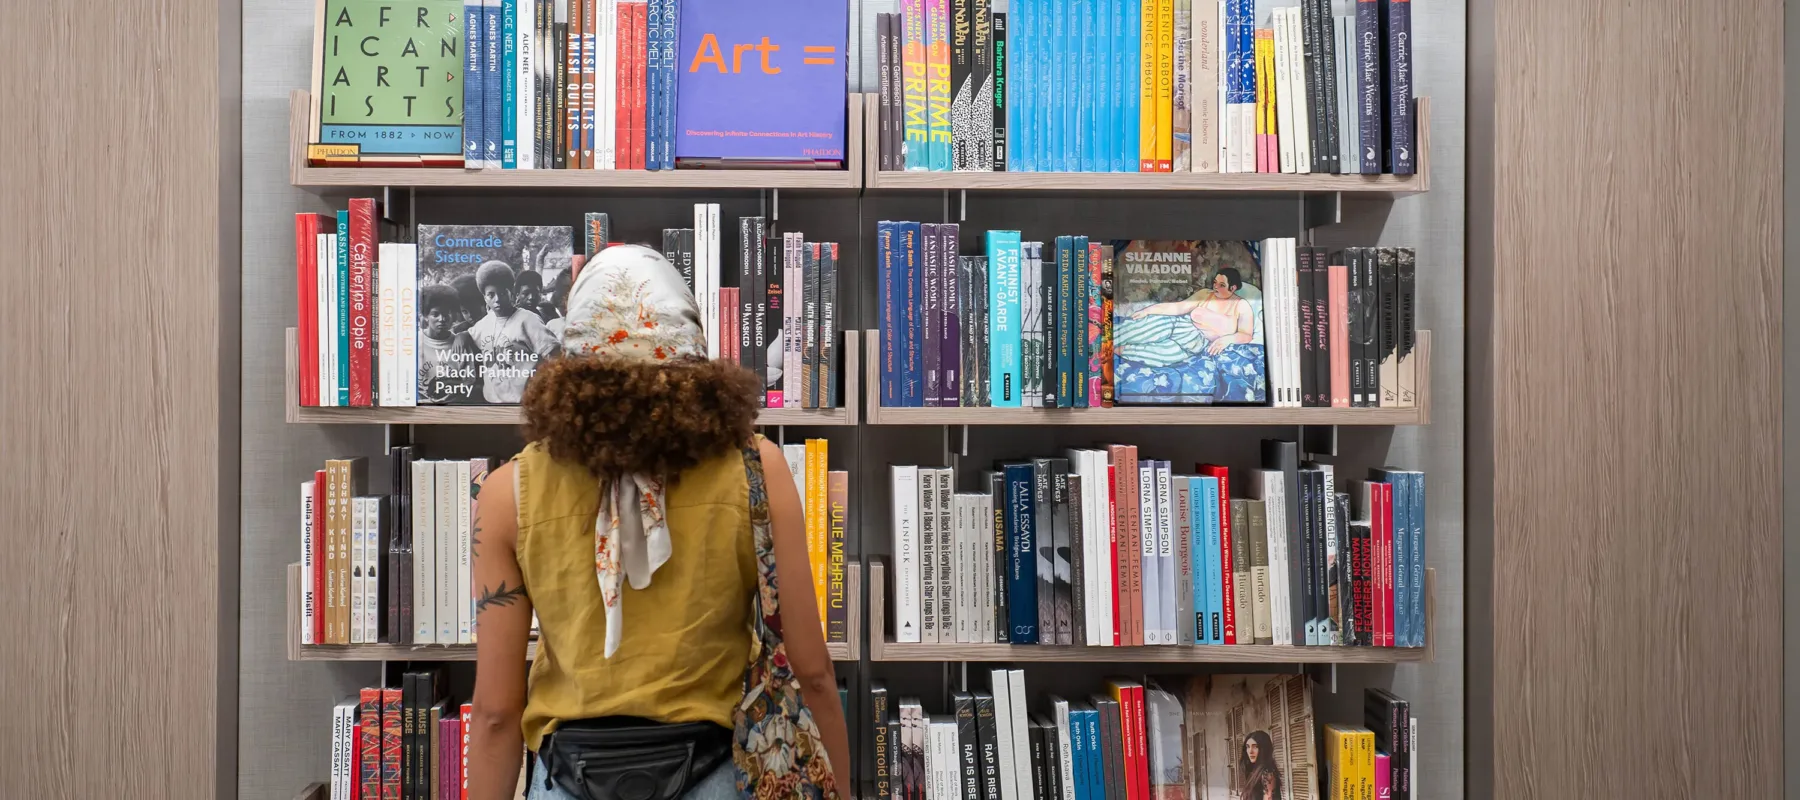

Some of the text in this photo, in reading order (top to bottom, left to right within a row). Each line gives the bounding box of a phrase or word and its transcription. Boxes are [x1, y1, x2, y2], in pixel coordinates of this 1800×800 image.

[906, 5, 914, 55] GENERATION
[1201, 20, 1209, 70] wonderland
[689, 33, 782, 75] Art
[567, 33, 579, 130] AMISH QUILTS
[582, 33, 594, 130] AMISH QUILTS
[995, 40, 1004, 108] Barbara Kruger
[1364, 32, 1374, 115] Carrie Mae Weems
[904, 61, 927, 142] PRIME
[929, 62, 951, 144] PRIME
[316, 148, 356, 156] PHAIDON
[331, 130, 455, 140] FROM 1882 NOW
[686, 130, 724, 138] Discovering
[809, 131, 833, 139] History
[338, 223, 346, 266] CASSATT
[435, 234, 502, 248] Comrade
[435, 251, 482, 264] Sisters
[1125, 252, 1192, 263] SUZANNE
[1007, 249, 1018, 304] FEMINIST
[1125, 264, 1192, 275] VALADON
[353, 243, 367, 349] Catherine Opie
[996, 248, 1007, 332] AVANT-GARDE
[435, 349, 538, 362] Women of the
[1060, 330, 1068, 357] Popular
[436, 365, 537, 378] Black Panther
[436, 381, 473, 398] Party
[924, 474, 933, 489] Kara
[1011, 481, 1019, 503] Crossing
[924, 489, 933, 510] Walker
[1019, 481, 1031, 552] LALLA ESSAYDI
[1142, 470, 1152, 554] LORNA SIMPSON
[1158, 471, 1169, 554] LORNA SIMPSON
[1325, 474, 1335, 547] LYNDA BENGLIS
[924, 516, 933, 531] Black
[924, 532, 934, 544] Hole
[995, 509, 1004, 552] KUSAMA
[1178, 488, 1190, 576] Louise Bourgeois
[304, 496, 313, 617] Hella Jongerius Misfit
[328, 529, 336, 560] KIND
[831, 501, 844, 609] JULIE MEHRETU
[1012, 535, 1020, 558] Bridging
[1352, 537, 1361, 576] MANON
[1396, 527, 1405, 588] Marguerite Gérard
[924, 551, 934, 580] Everything
[925, 585, 934, 598] Star
[1238, 574, 1247, 609] Hurtado
[1256, 568, 1265, 603] Hurtado
[924, 599, 934, 615] Longs
[1353, 580, 1362, 632] FEATHERS
[418, 708, 426, 734] MUSE
[876, 727, 889, 796] Polaroid 54
[965, 744, 973, 764] RAP
[966, 766, 974, 775] IS
